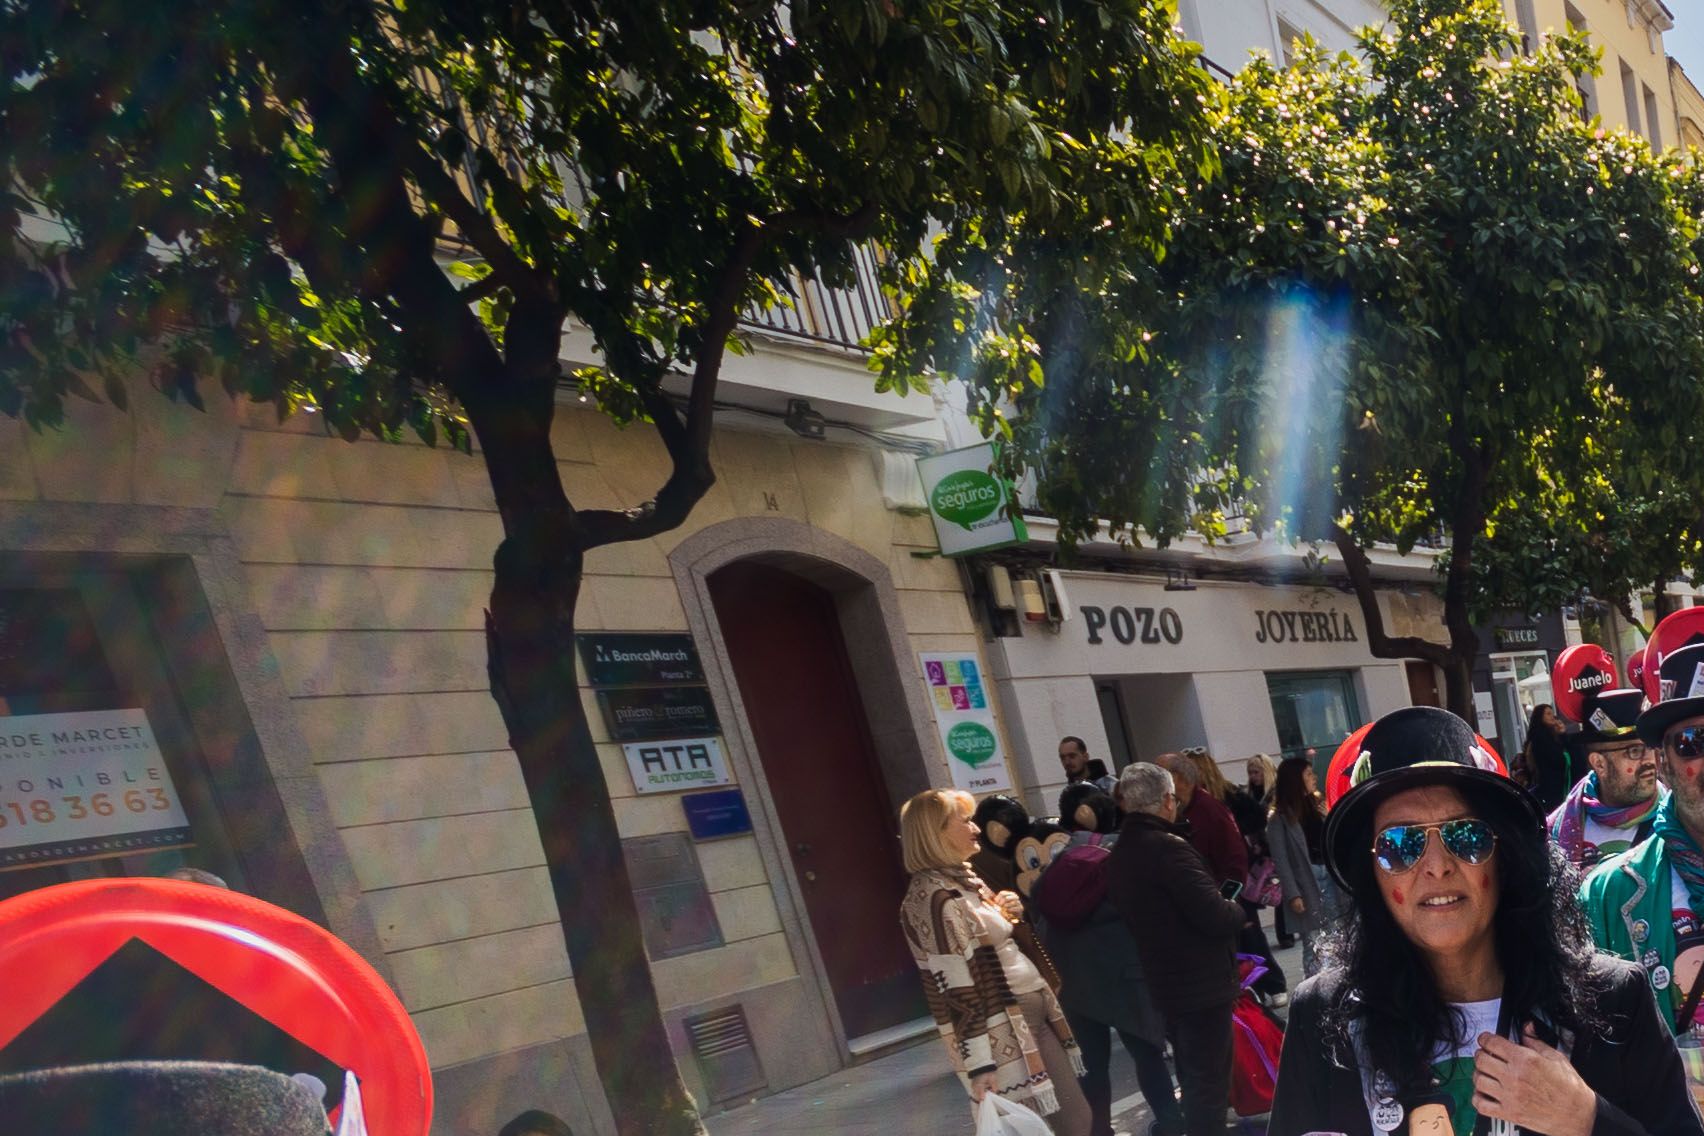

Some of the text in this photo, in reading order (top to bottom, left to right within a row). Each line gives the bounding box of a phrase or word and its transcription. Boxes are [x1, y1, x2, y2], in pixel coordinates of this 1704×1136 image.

[937, 485, 996, 510] seguros
[1080, 605, 1358, 645] POZO JOYERÍA
[612, 649, 688, 663] BancaMarch
[1567, 673, 1613, 693] Juanelo
[52, 726, 143, 744] MARCET
[639, 744, 713, 773] ATA
[0, 767, 161, 793] ONIBLE
[62, 793, 115, 820] 36
[123, 787, 171, 813] 63
